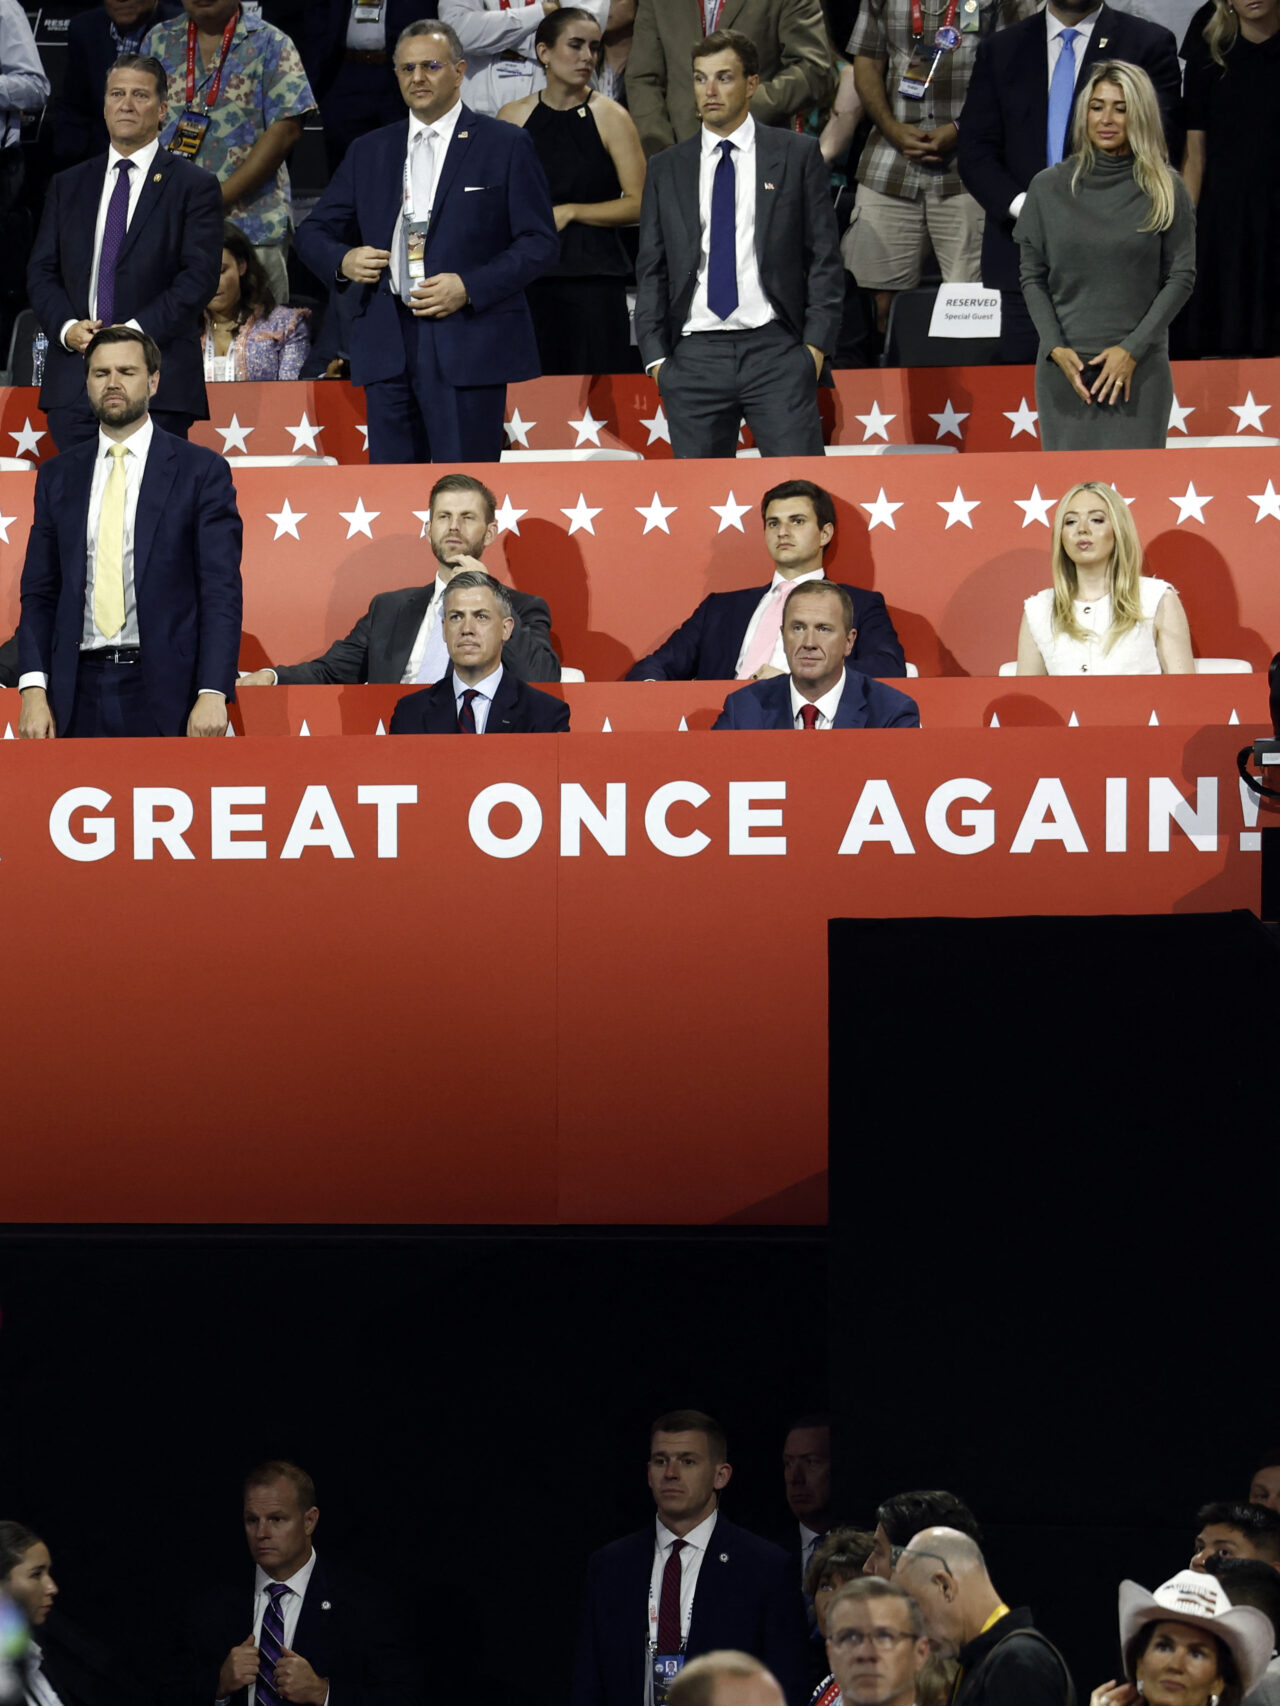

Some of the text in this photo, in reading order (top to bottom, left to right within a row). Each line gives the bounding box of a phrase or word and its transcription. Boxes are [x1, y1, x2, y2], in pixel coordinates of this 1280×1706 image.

[945, 298, 998, 307] RESERVED
[944, 312, 971, 321] Special
[48, 784, 418, 862] GREAT
[467, 780, 787, 859] ONCE
[837, 776, 1263, 855] AGAIN!
